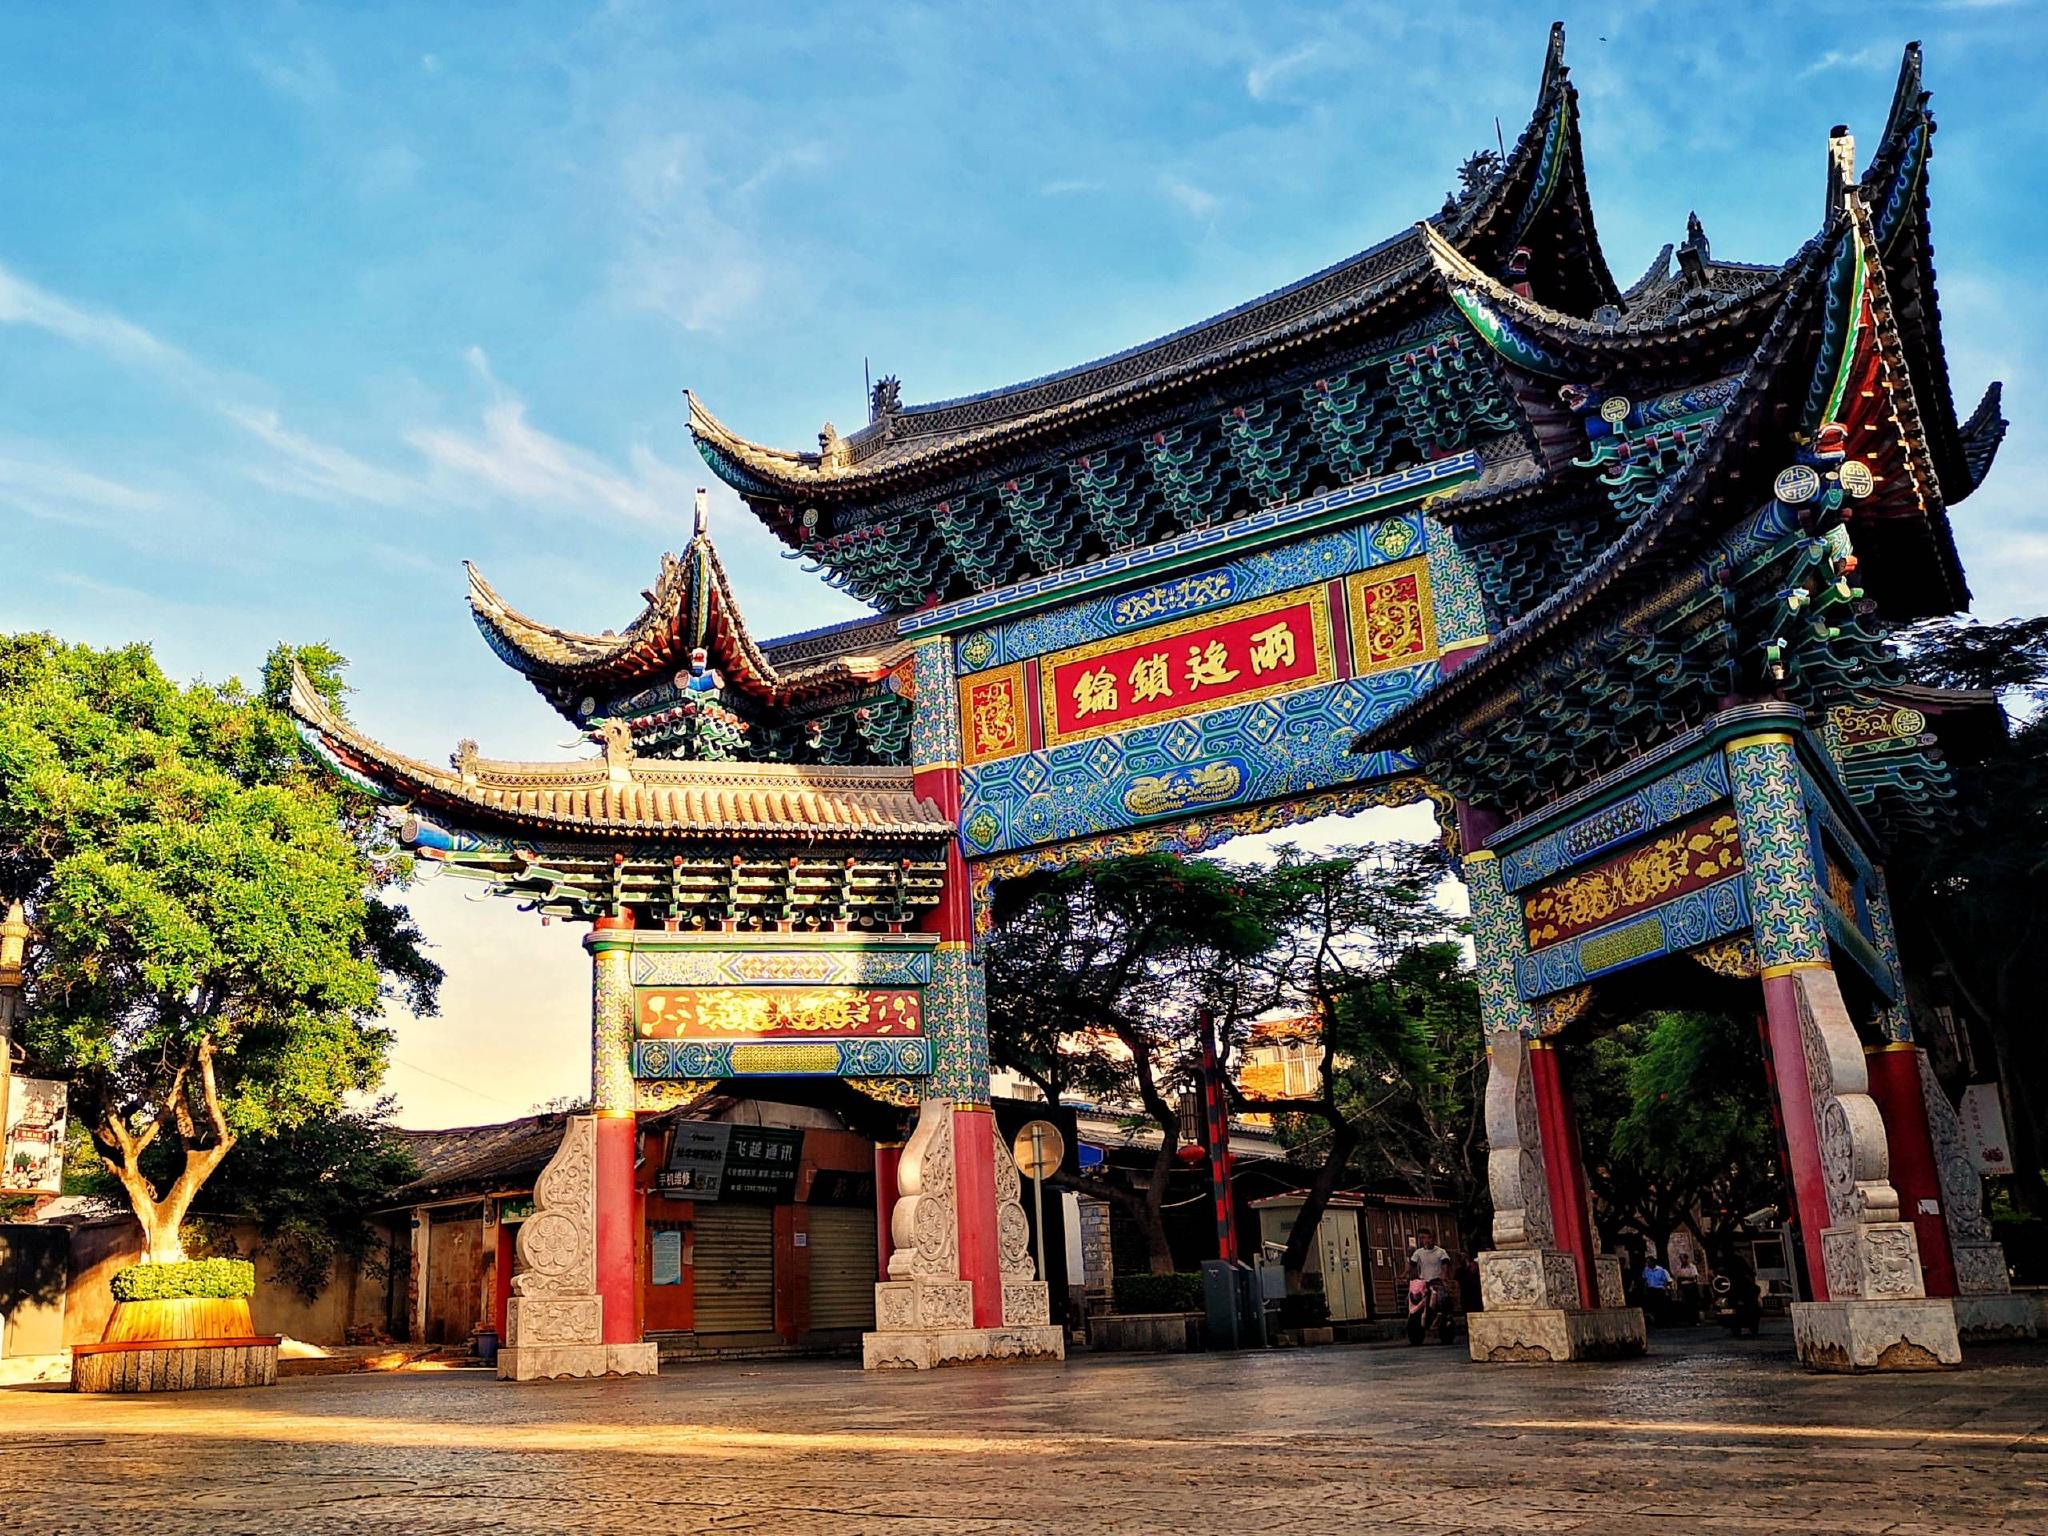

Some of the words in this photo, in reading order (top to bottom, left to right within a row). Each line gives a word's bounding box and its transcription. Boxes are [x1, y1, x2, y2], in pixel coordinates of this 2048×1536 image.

[735, 1140, 793, 1161] 飞越通讯
[658, 1170, 691, 1187] 手机维修
